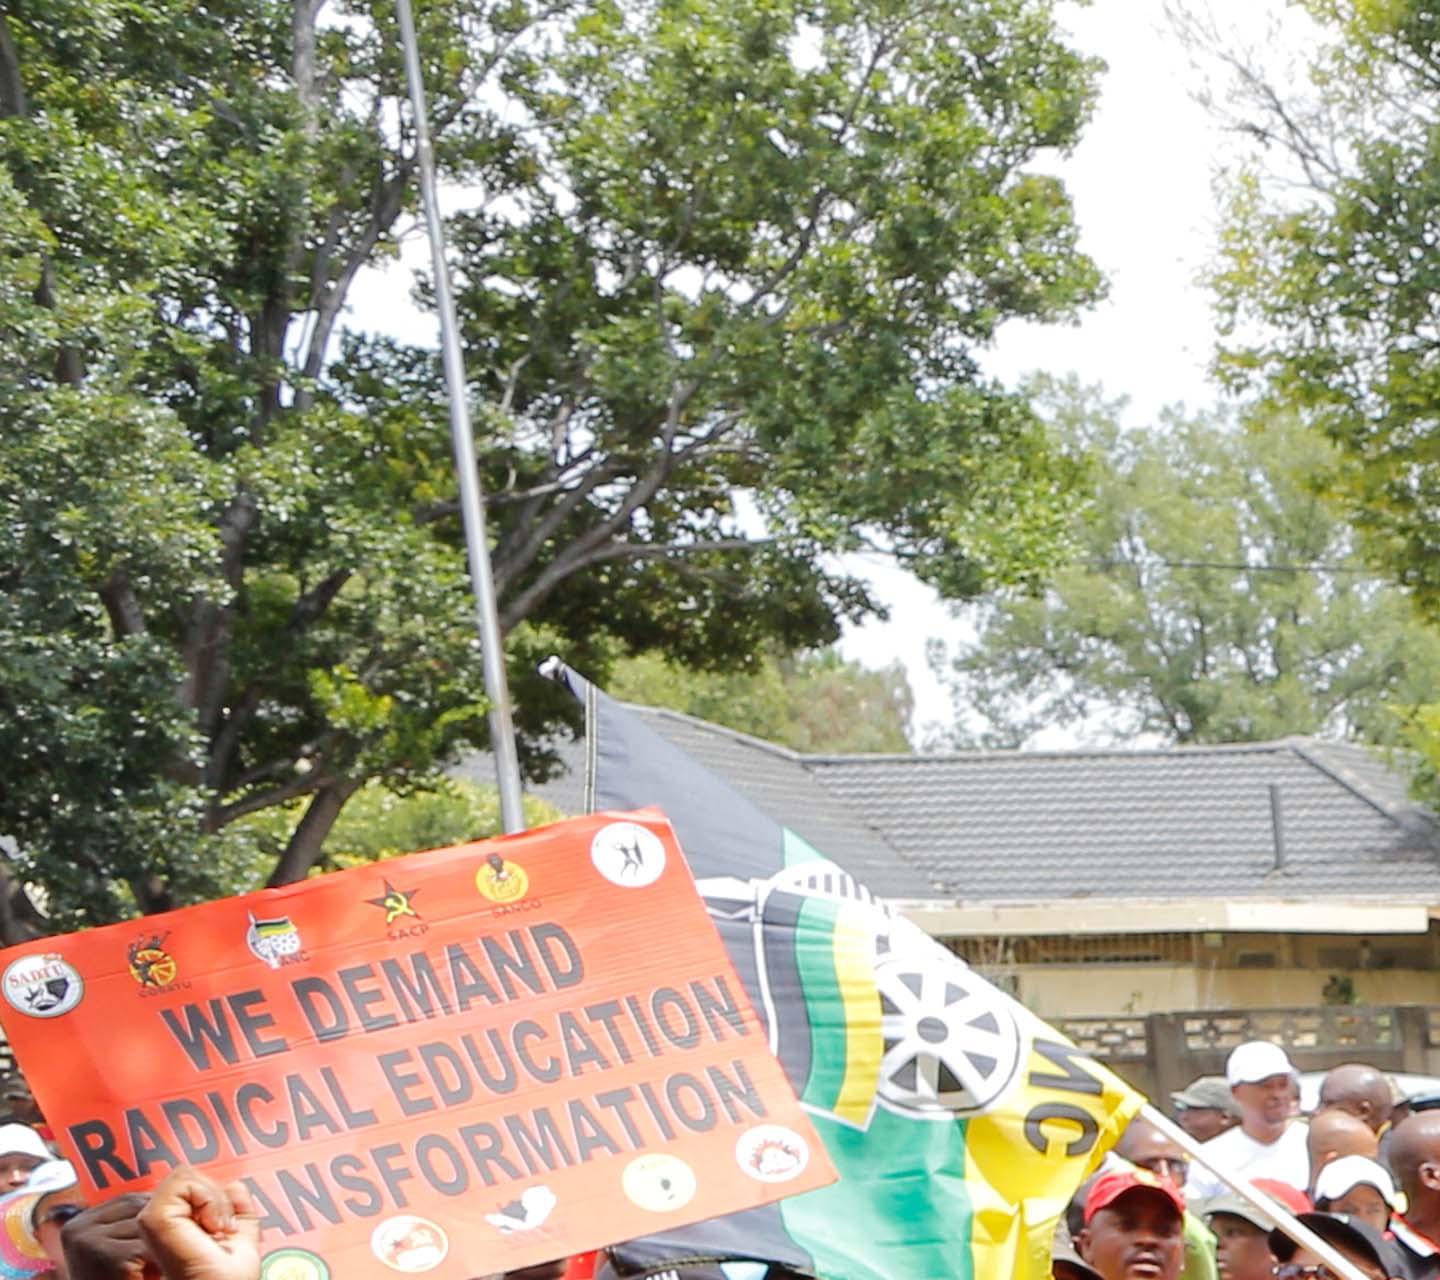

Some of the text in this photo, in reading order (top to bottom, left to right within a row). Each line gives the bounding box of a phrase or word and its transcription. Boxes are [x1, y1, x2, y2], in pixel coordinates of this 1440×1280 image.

[280, 951, 311, 967] ANC
[387, 923, 430, 941] SACP
[8, 964, 64, 987] SADTU
[160, 921, 584, 1071] WE DEMAND
[69, 975, 752, 1190] RADICAL EDUCATION
[239, 1060, 768, 1238] ANSFORMATION
